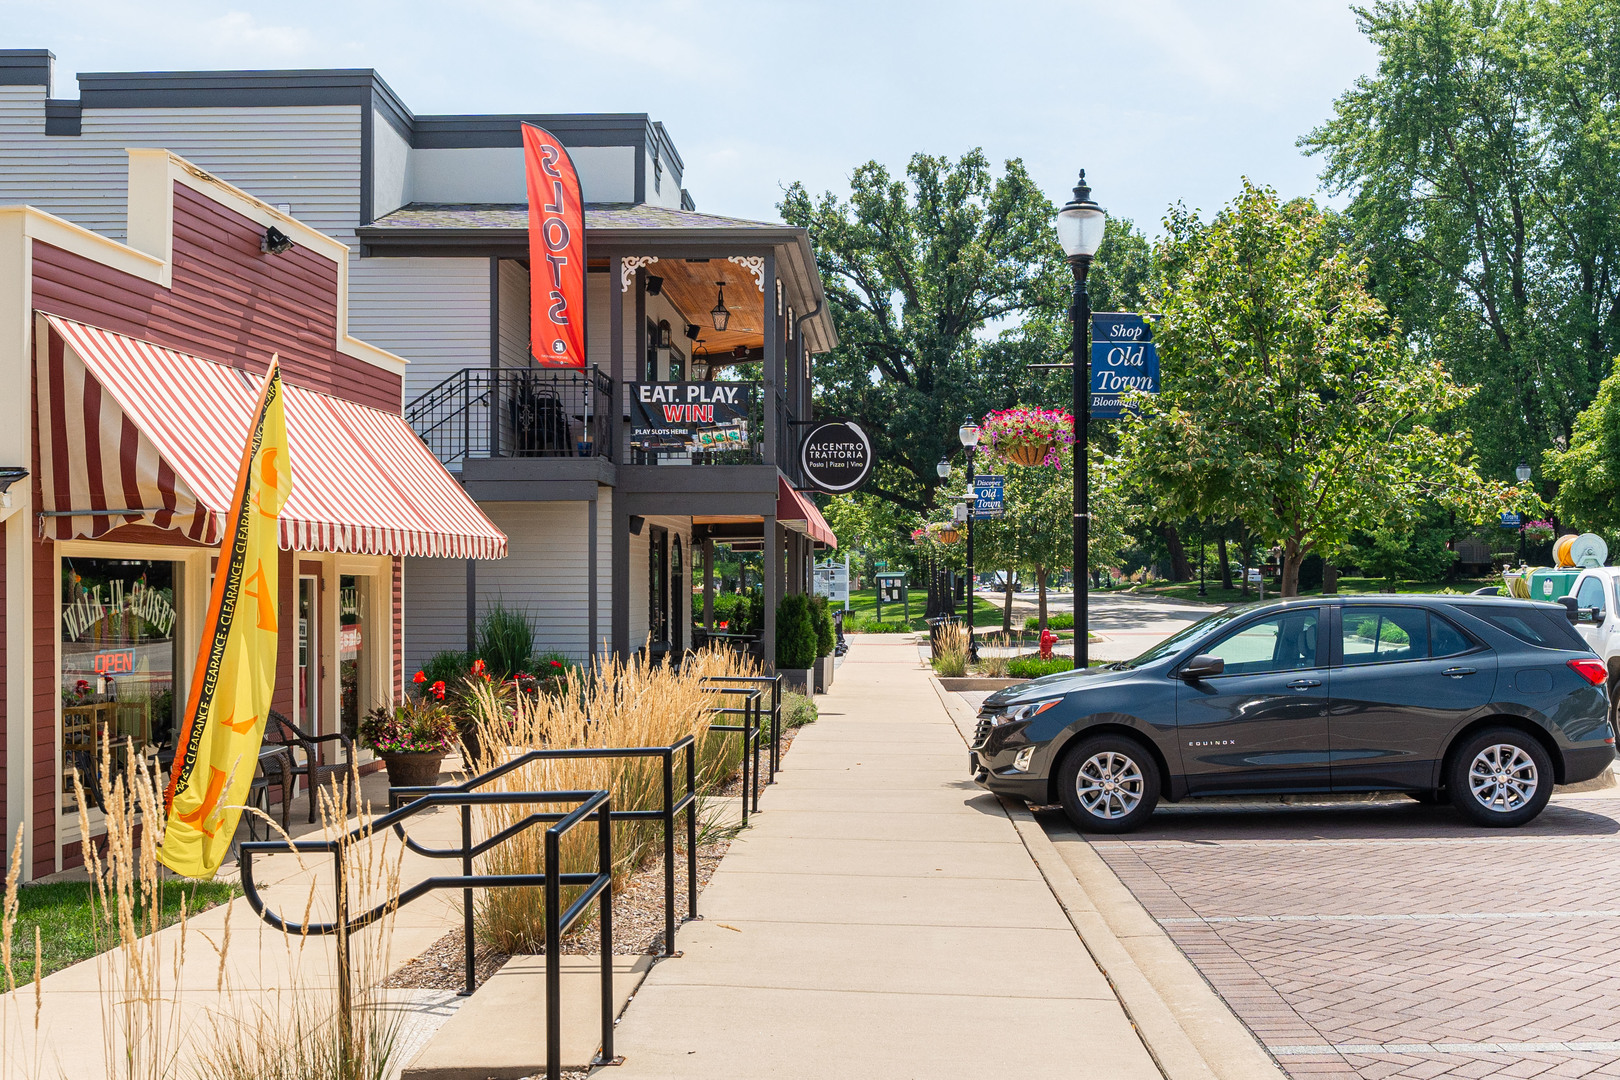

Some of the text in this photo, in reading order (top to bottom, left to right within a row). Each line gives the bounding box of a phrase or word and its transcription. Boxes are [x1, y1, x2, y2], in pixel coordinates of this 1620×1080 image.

[1110, 324, 1142, 340] Shop
[1107, 346, 1145, 366] Old
[1097, 371, 1153, 390] Town
[640, 385, 739, 404] EAT. PLAY.
[663, 404, 714, 423] WIN!
[809, 442, 864, 451] ALCENTRO
[809, 451, 864, 459] TRATTORIA
[981, 489, 997, 498] Old
[977, 499, 1001, 508] Town
[131, 581, 177, 640] CLOSET
[94, 652, 133, 673] OPEN
[186, 701, 210, 765] CLEARANCE
[204, 632, 227, 696] CLEARANCE
[220, 561, 243, 626] CLEARANCE
